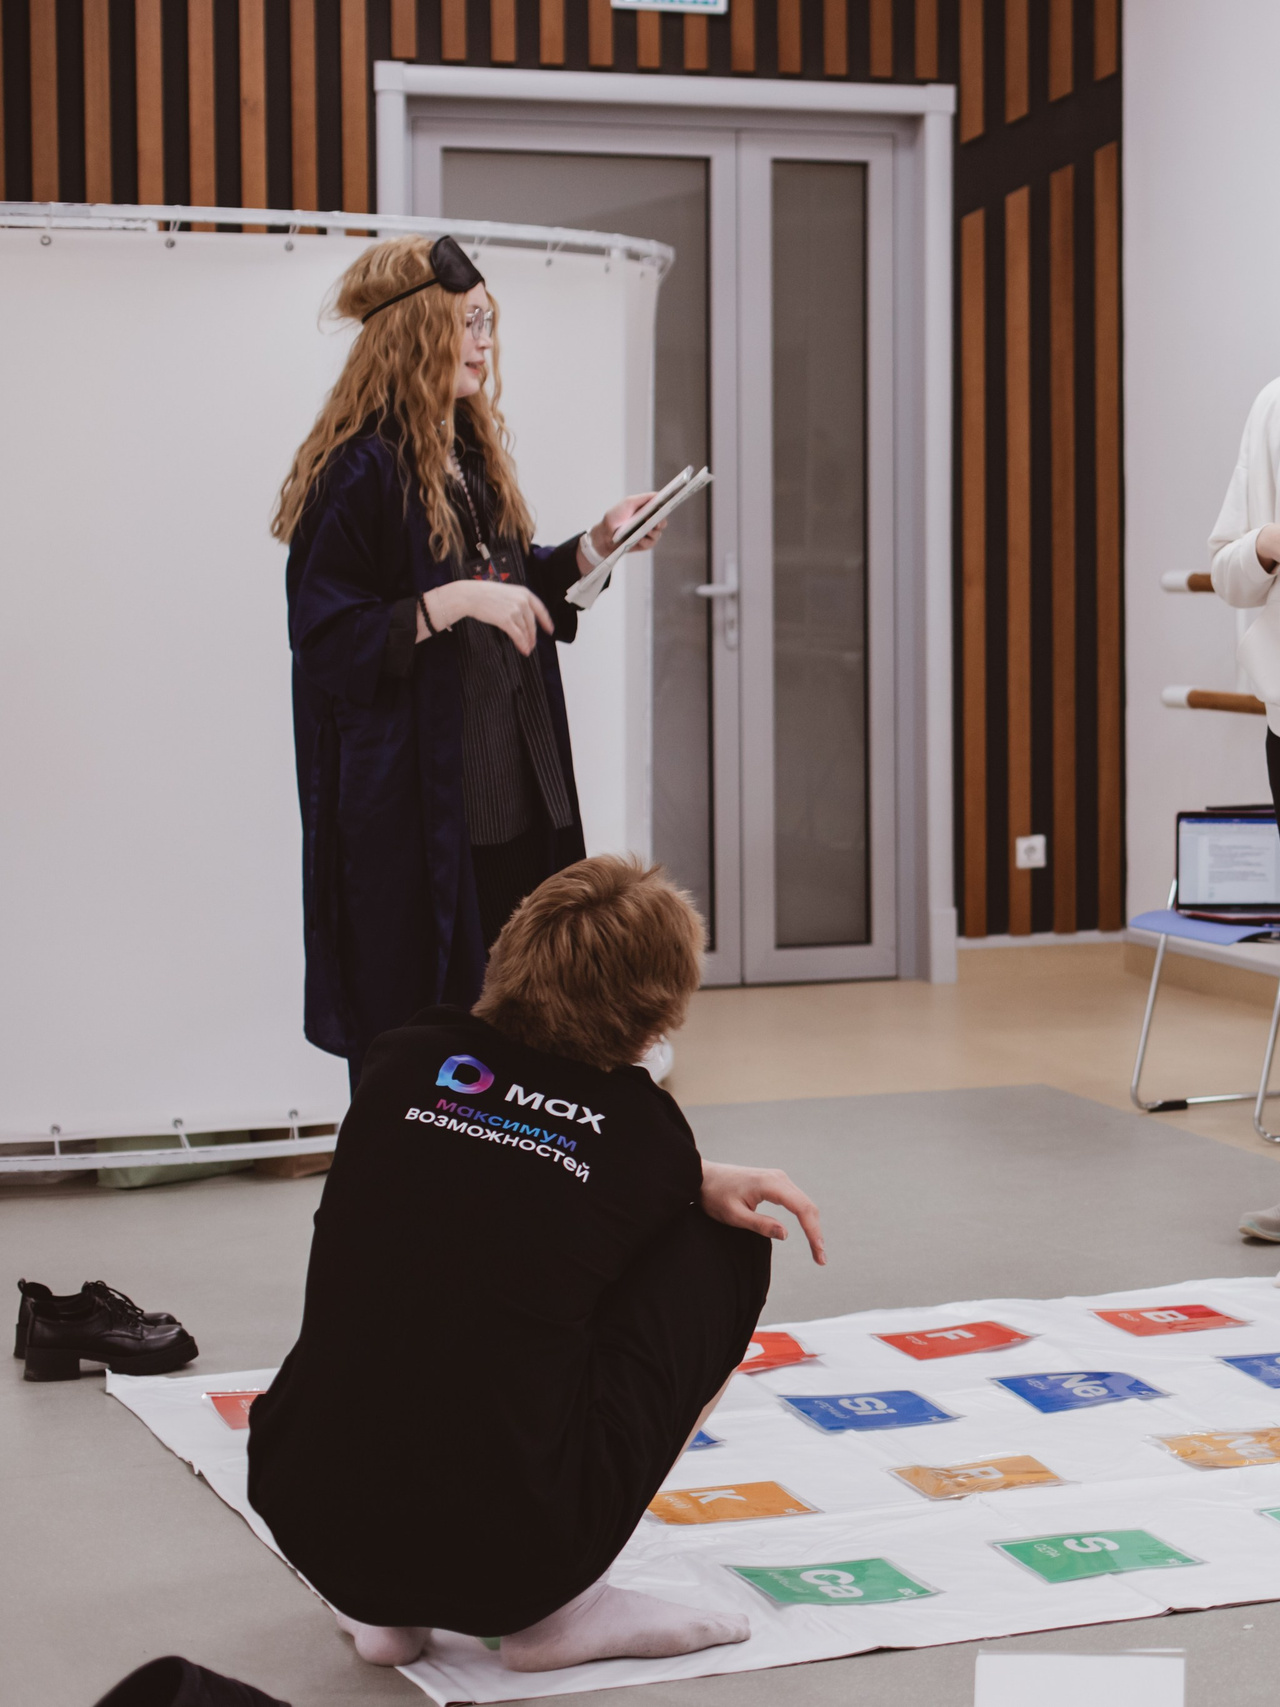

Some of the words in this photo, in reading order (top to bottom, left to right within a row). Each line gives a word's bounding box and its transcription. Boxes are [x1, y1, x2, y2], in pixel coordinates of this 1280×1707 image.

[435, 1098, 578, 1152] максимум
[404, 1107, 591, 1183] возможностей
[925, 1328, 976, 1341] F
[1047, 1373, 1108, 1398] Ne
[838, 1396, 899, 1416] Si
[690, 1488, 748, 1505] K
[1062, 1536, 1121, 1553] S
[799, 1568, 864, 1598] Ca
